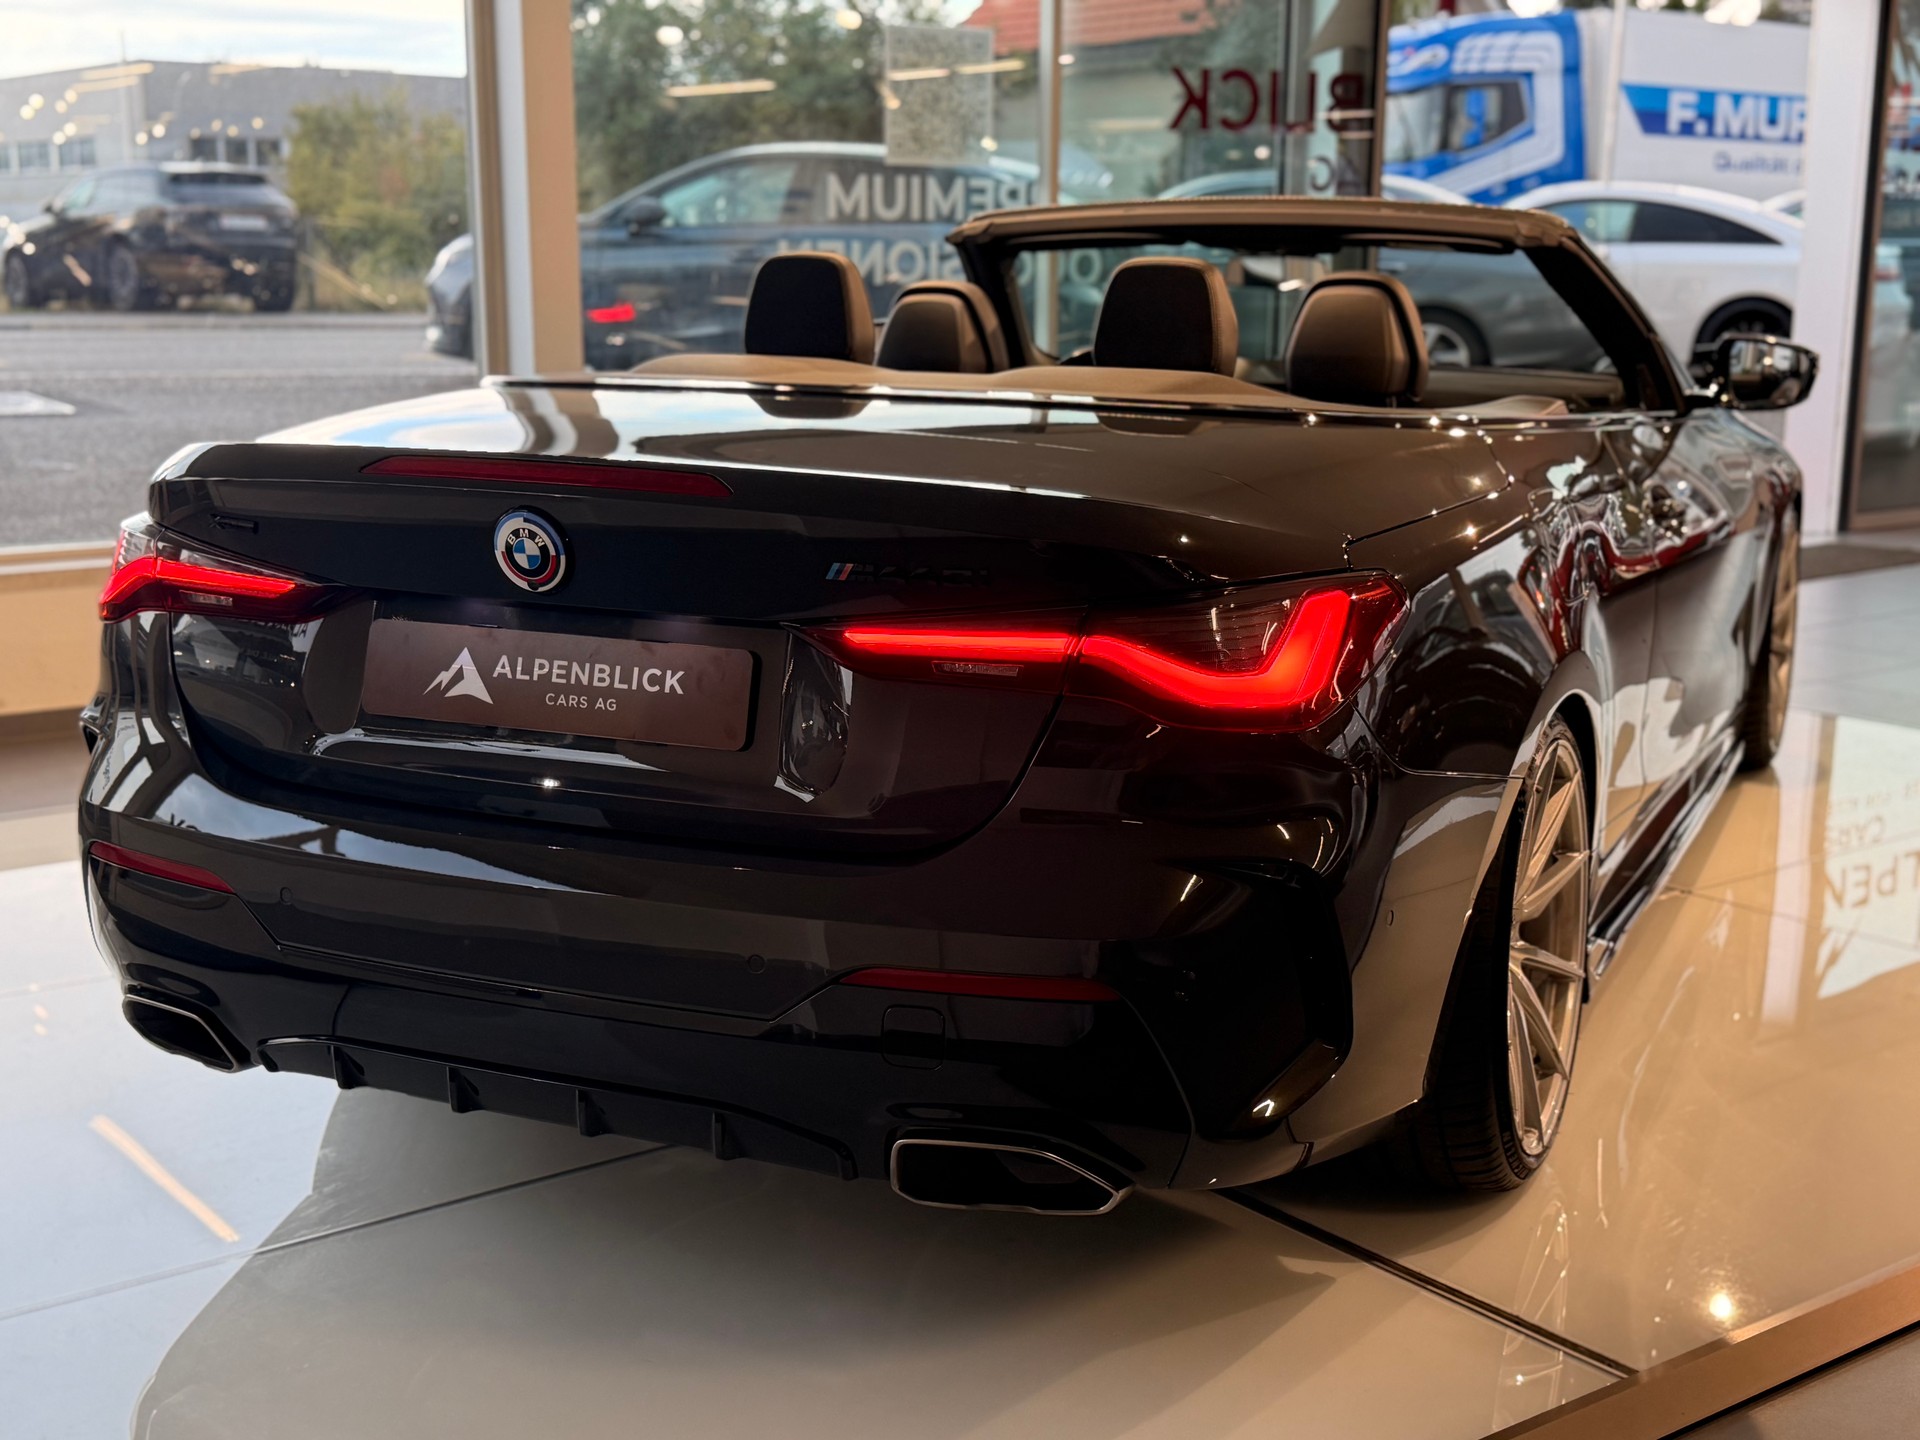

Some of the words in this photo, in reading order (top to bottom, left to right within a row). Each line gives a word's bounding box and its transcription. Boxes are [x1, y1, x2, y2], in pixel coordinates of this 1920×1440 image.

[507, 528, 545, 547] BMW
[492, 654, 686, 695] ALPENBLICK
[545, 693, 589, 709] CARS
[594, 697, 617, 711] AG
